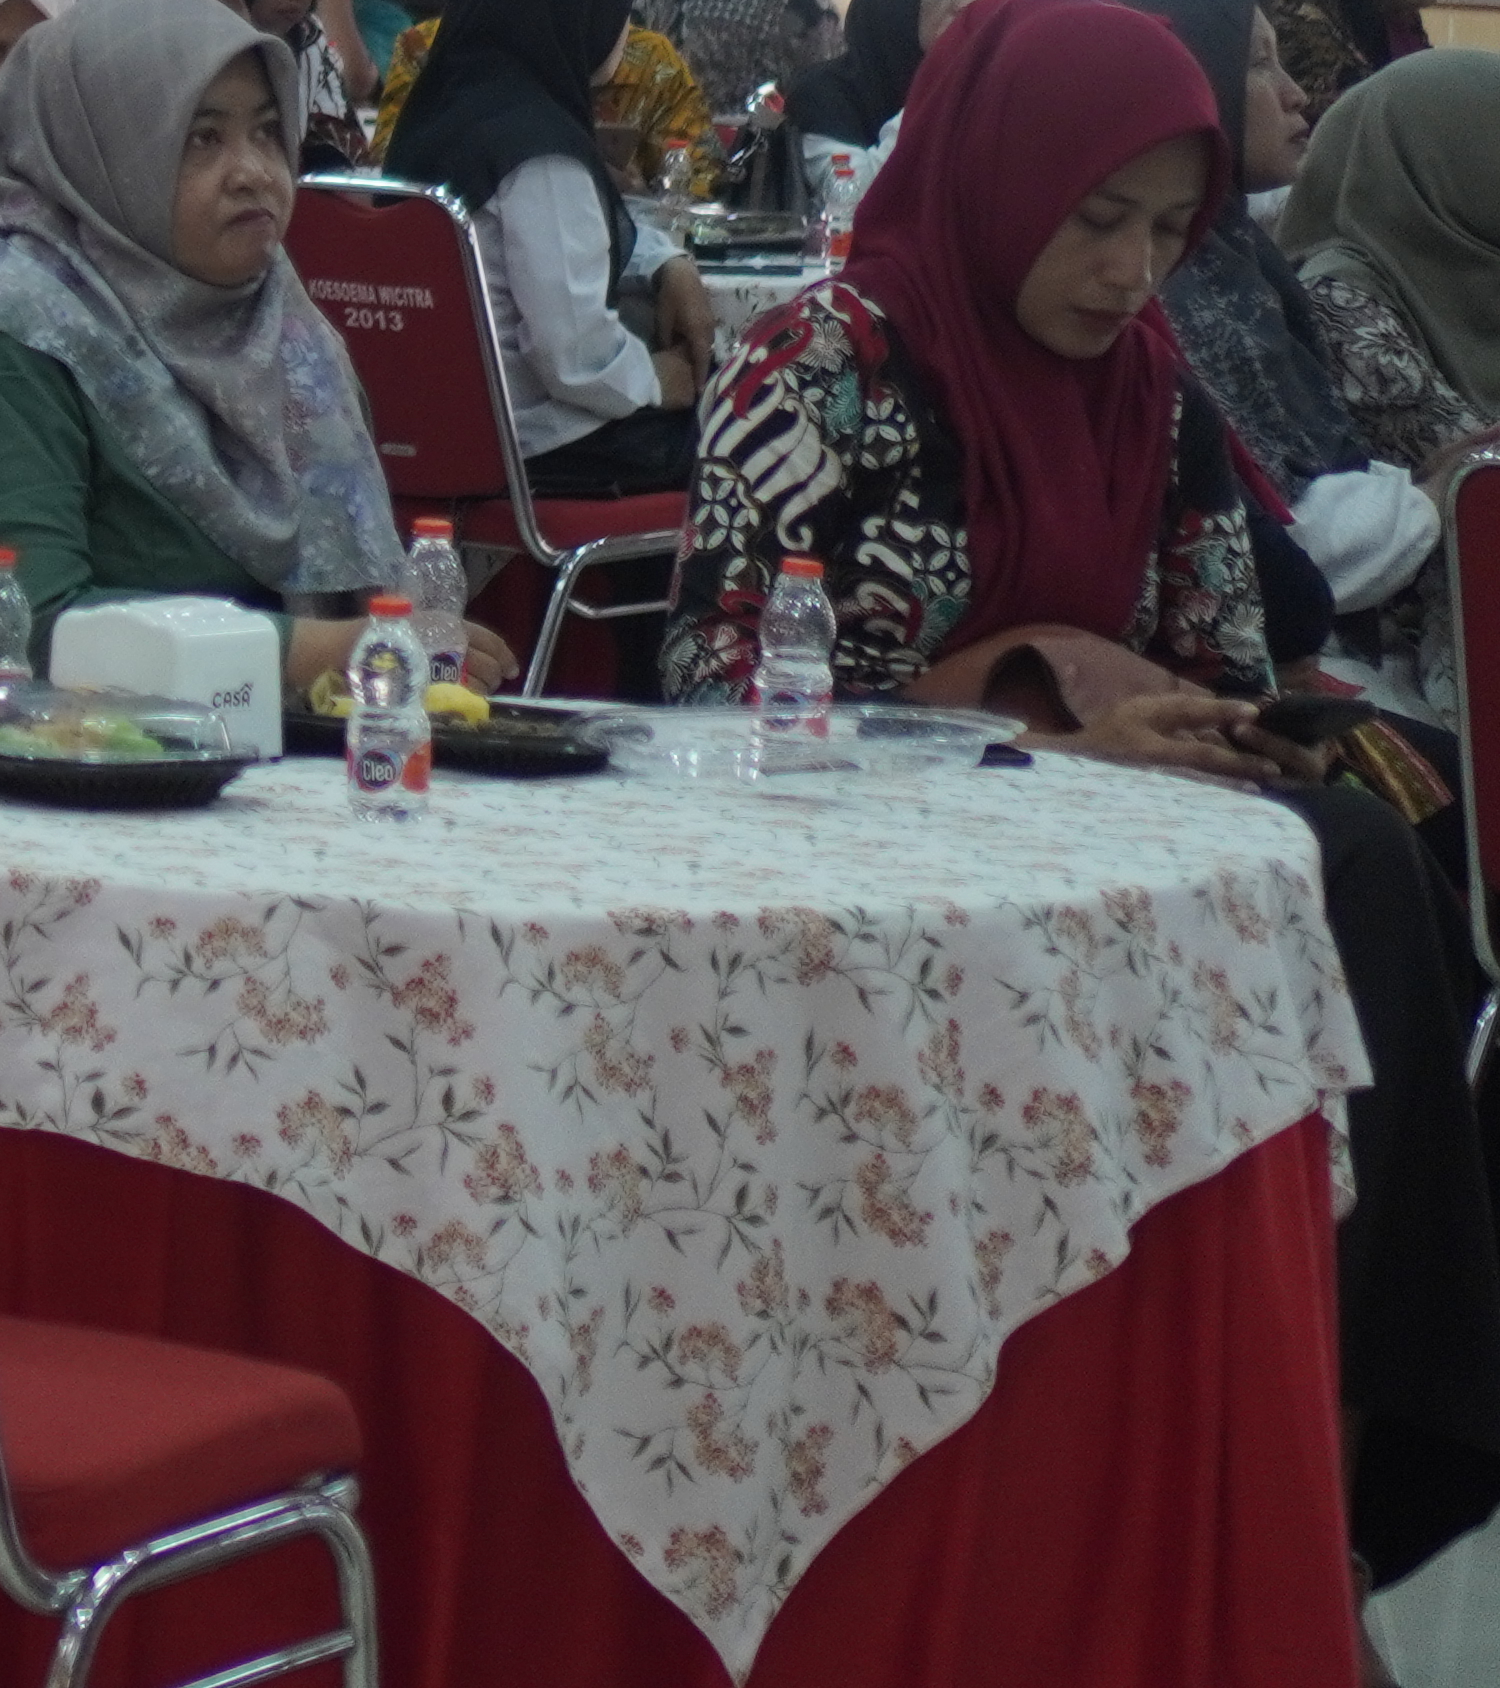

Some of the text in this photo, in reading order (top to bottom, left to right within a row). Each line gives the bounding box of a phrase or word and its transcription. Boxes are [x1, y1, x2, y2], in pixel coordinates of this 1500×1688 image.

[308, 278, 434, 309] KOESOEMA WICITRA
[344, 307, 404, 332] 2013
[431, 662, 458, 681] Cleo
[212, 691, 251, 709] CASA
[362, 761, 394, 782] Cleo
